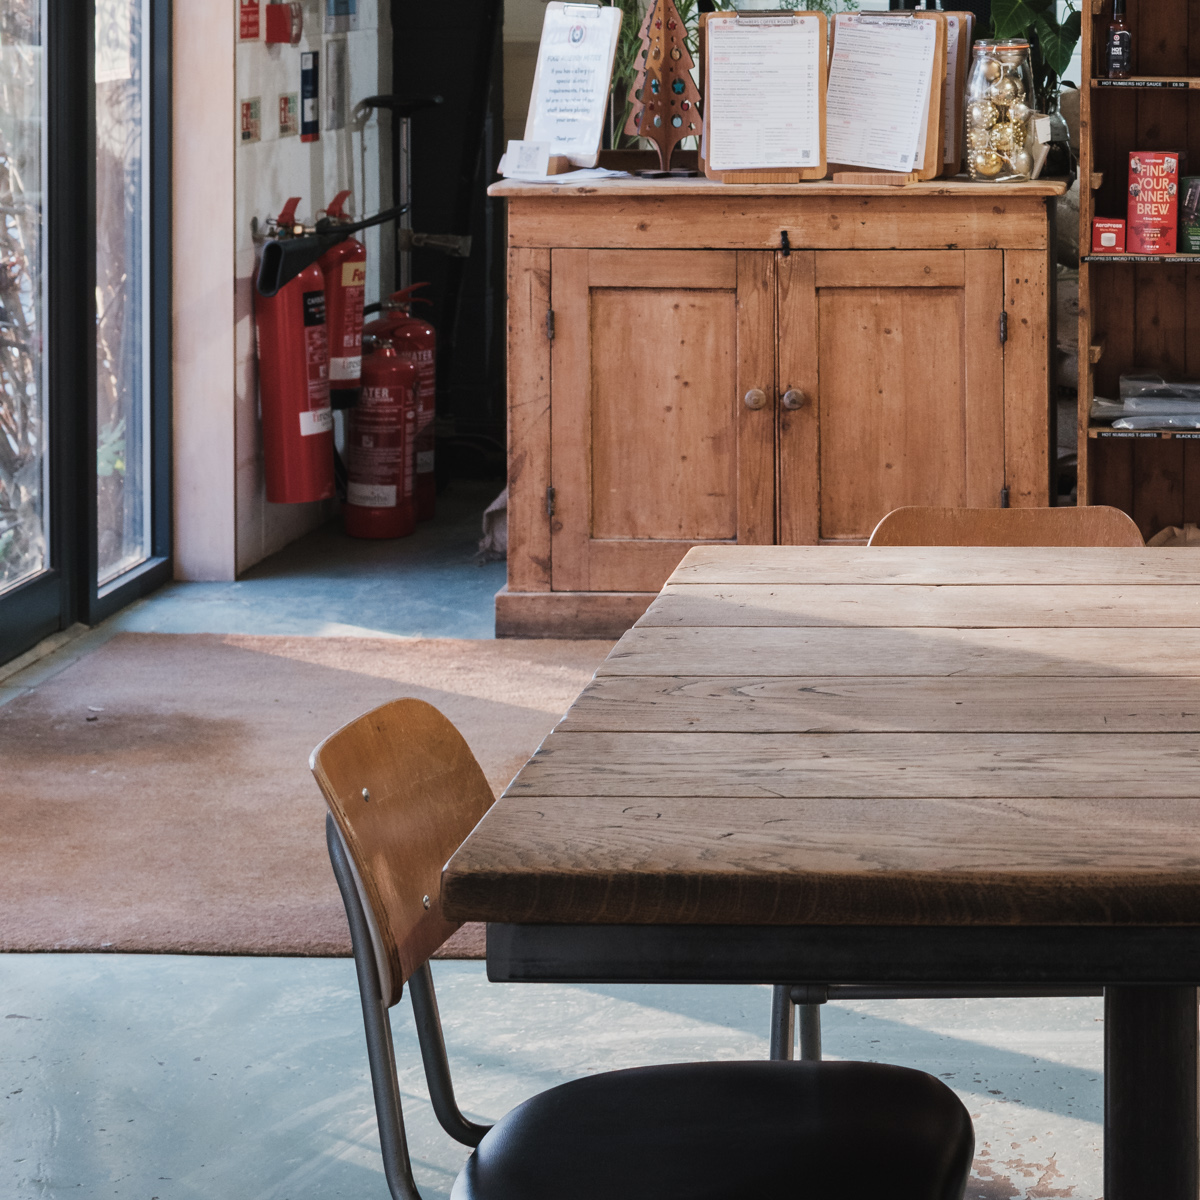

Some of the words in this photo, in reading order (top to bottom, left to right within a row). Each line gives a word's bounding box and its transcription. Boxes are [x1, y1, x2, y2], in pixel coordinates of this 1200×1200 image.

[1140, 165, 1167, 176] FIND
[1138, 178, 1170, 189] YOUR
[362, 388, 389, 398] ATER
